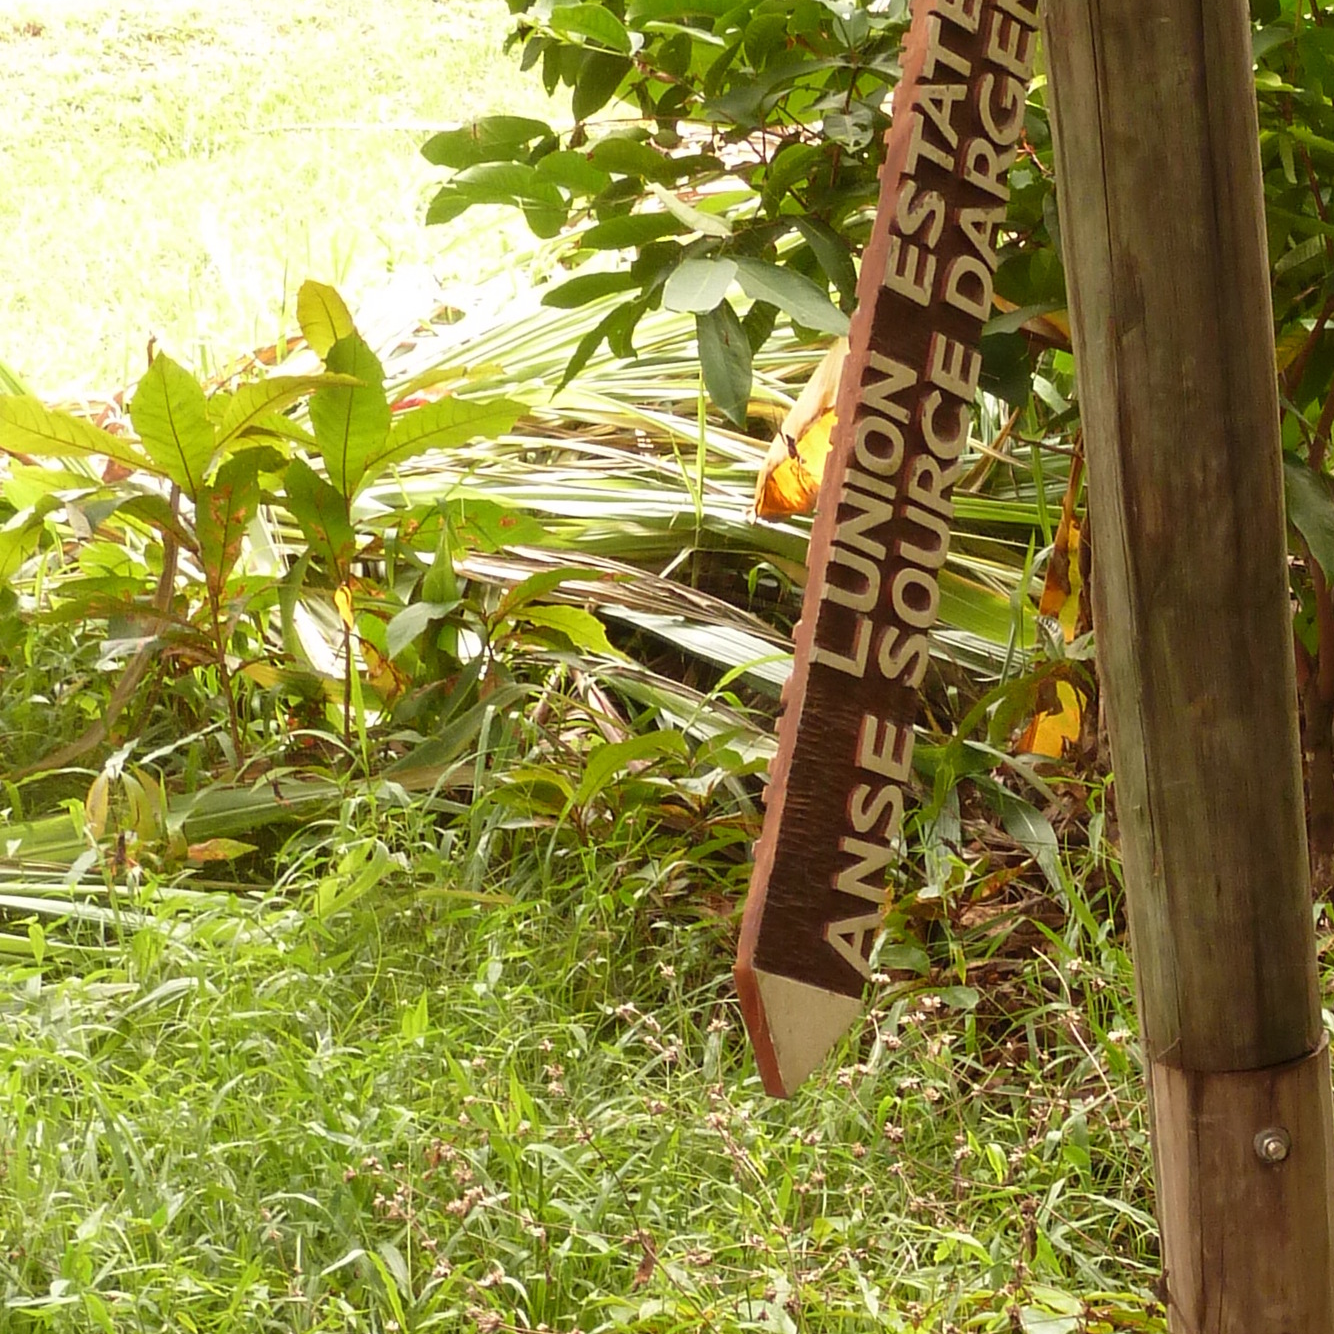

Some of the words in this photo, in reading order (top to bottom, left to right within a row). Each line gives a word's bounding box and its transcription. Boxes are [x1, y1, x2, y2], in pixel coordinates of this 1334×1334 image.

[811, 350, 918, 678] LUNION
[824, 713, 917, 982] ANSE
[877, 332, 983, 690] SOURCE
